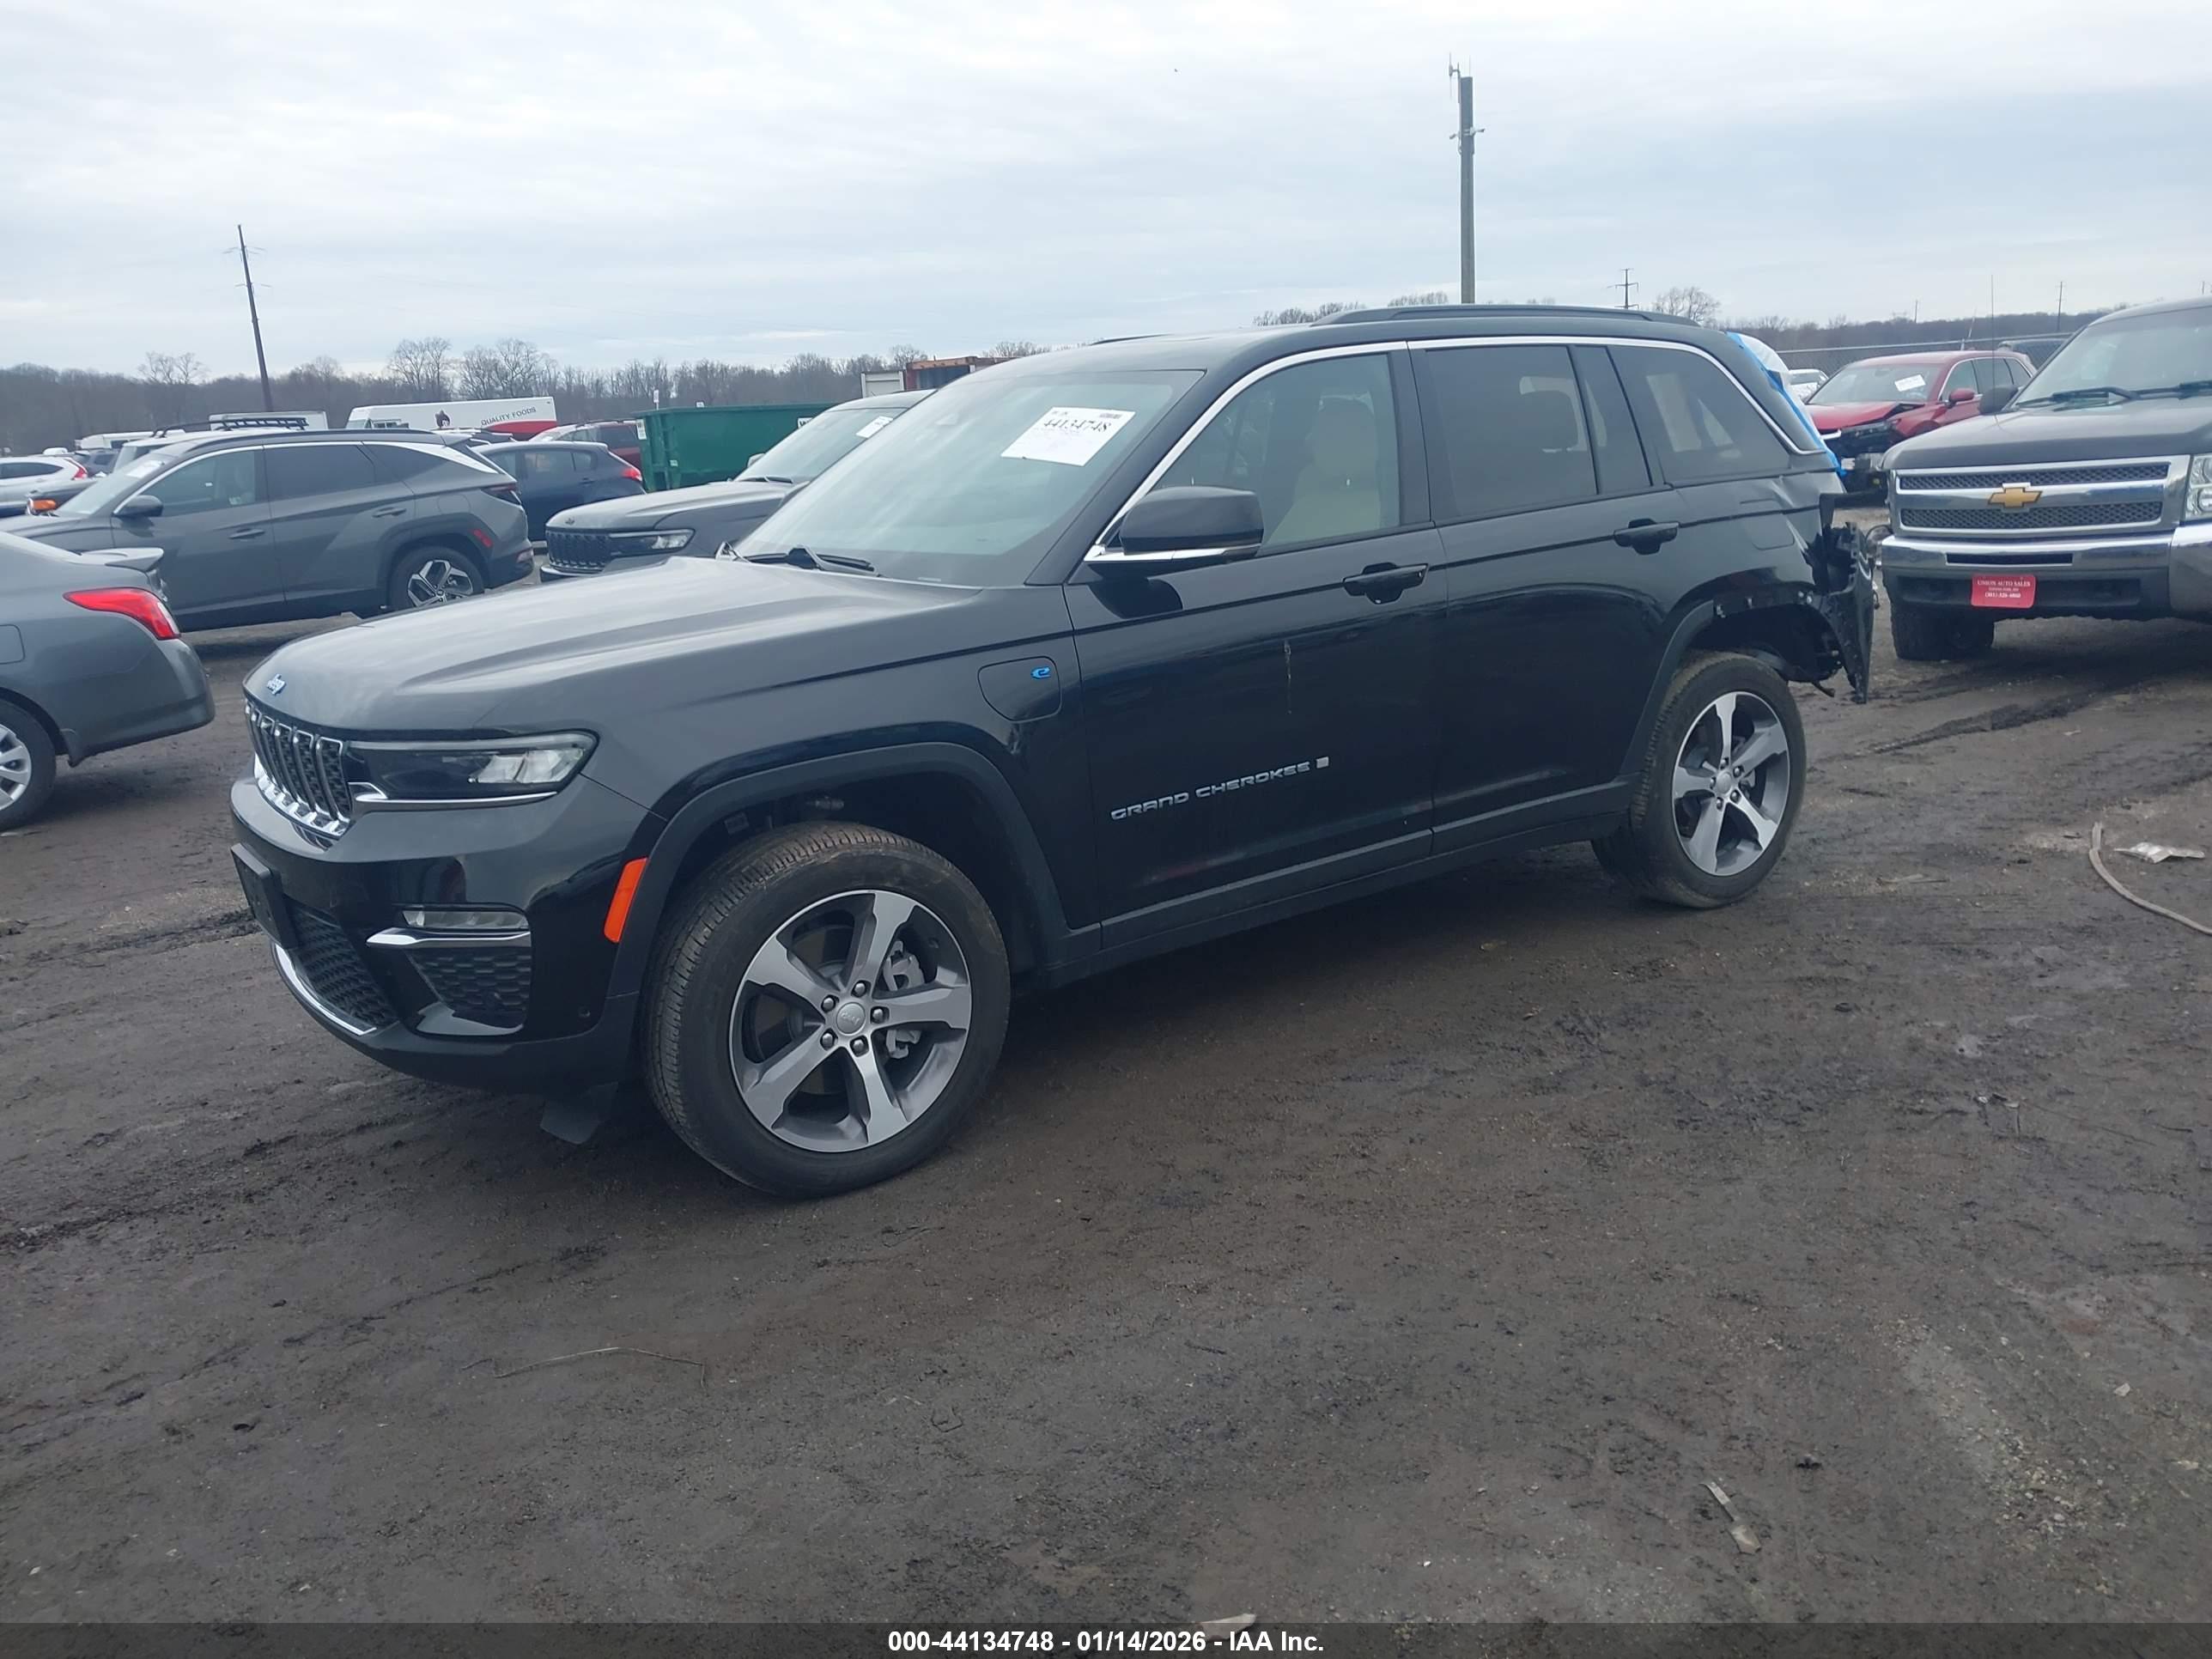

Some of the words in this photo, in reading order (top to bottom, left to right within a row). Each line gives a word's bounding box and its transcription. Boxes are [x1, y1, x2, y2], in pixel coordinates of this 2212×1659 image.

[481, 414, 510, 426] QUALITY
[513, 406, 536, 418] FOODS
[1111, 793, 1188, 820] GRAND
[1196, 762, 1310, 798] CHEROKEE
